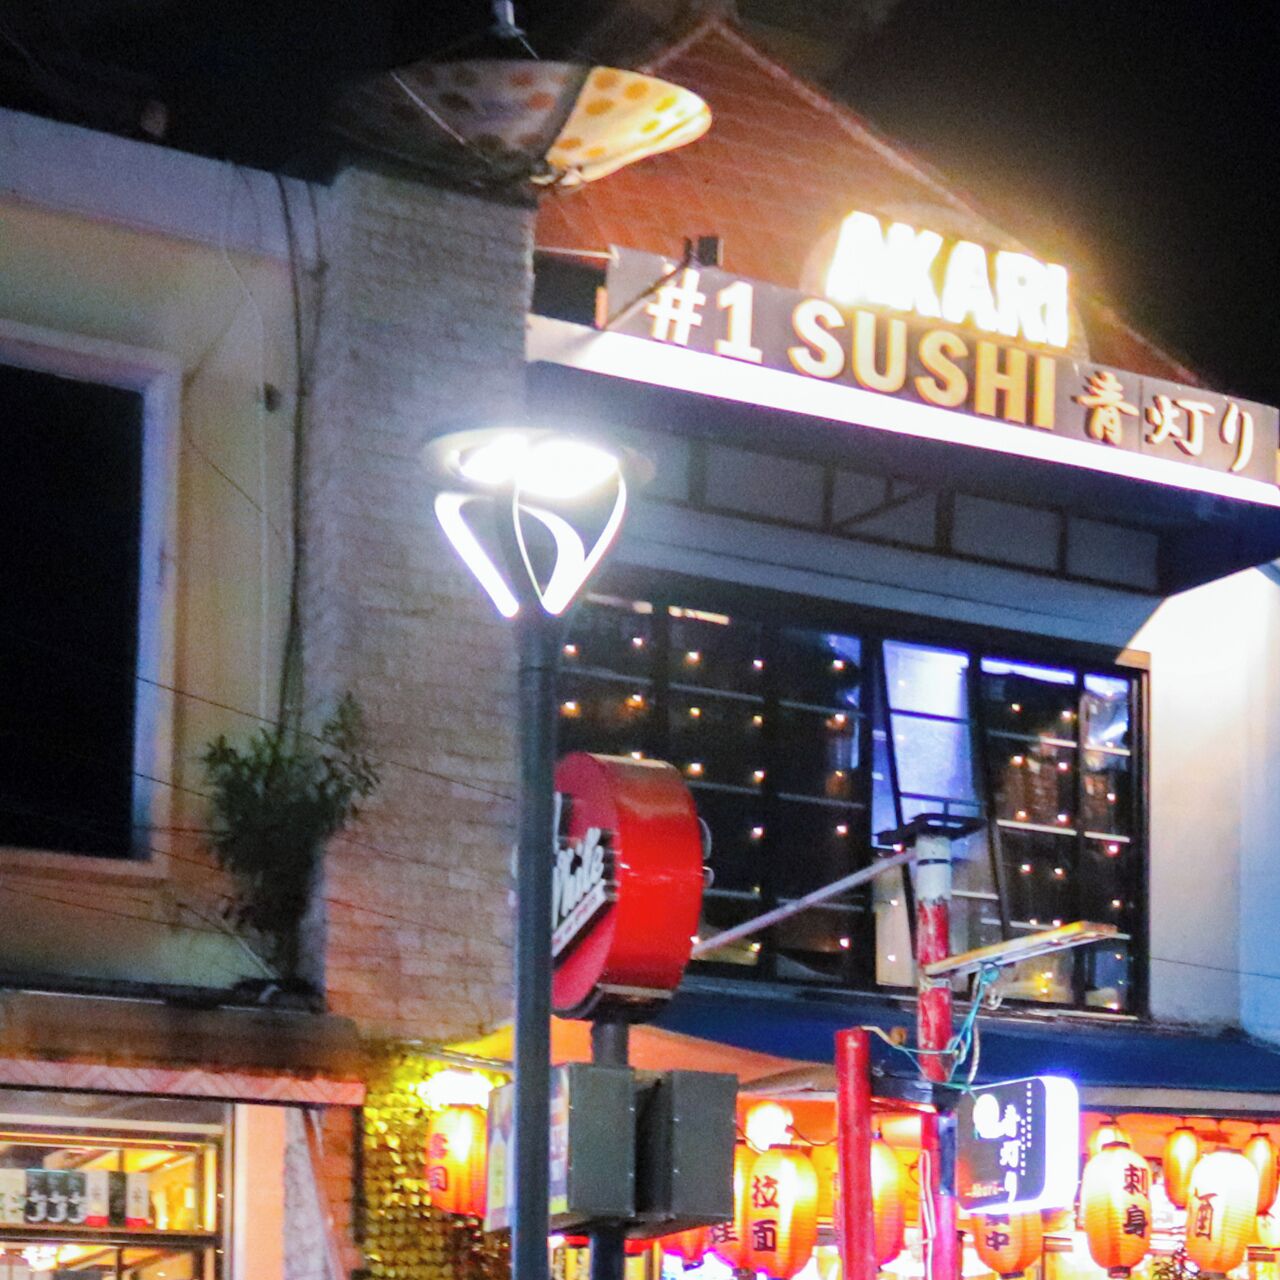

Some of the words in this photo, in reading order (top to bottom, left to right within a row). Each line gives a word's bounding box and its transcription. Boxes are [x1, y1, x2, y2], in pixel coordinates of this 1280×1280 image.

[646, 265, 764, 364] #1
[789, 298, 1056, 430] SUSHI
[827, 210, 1070, 347] AKARI
